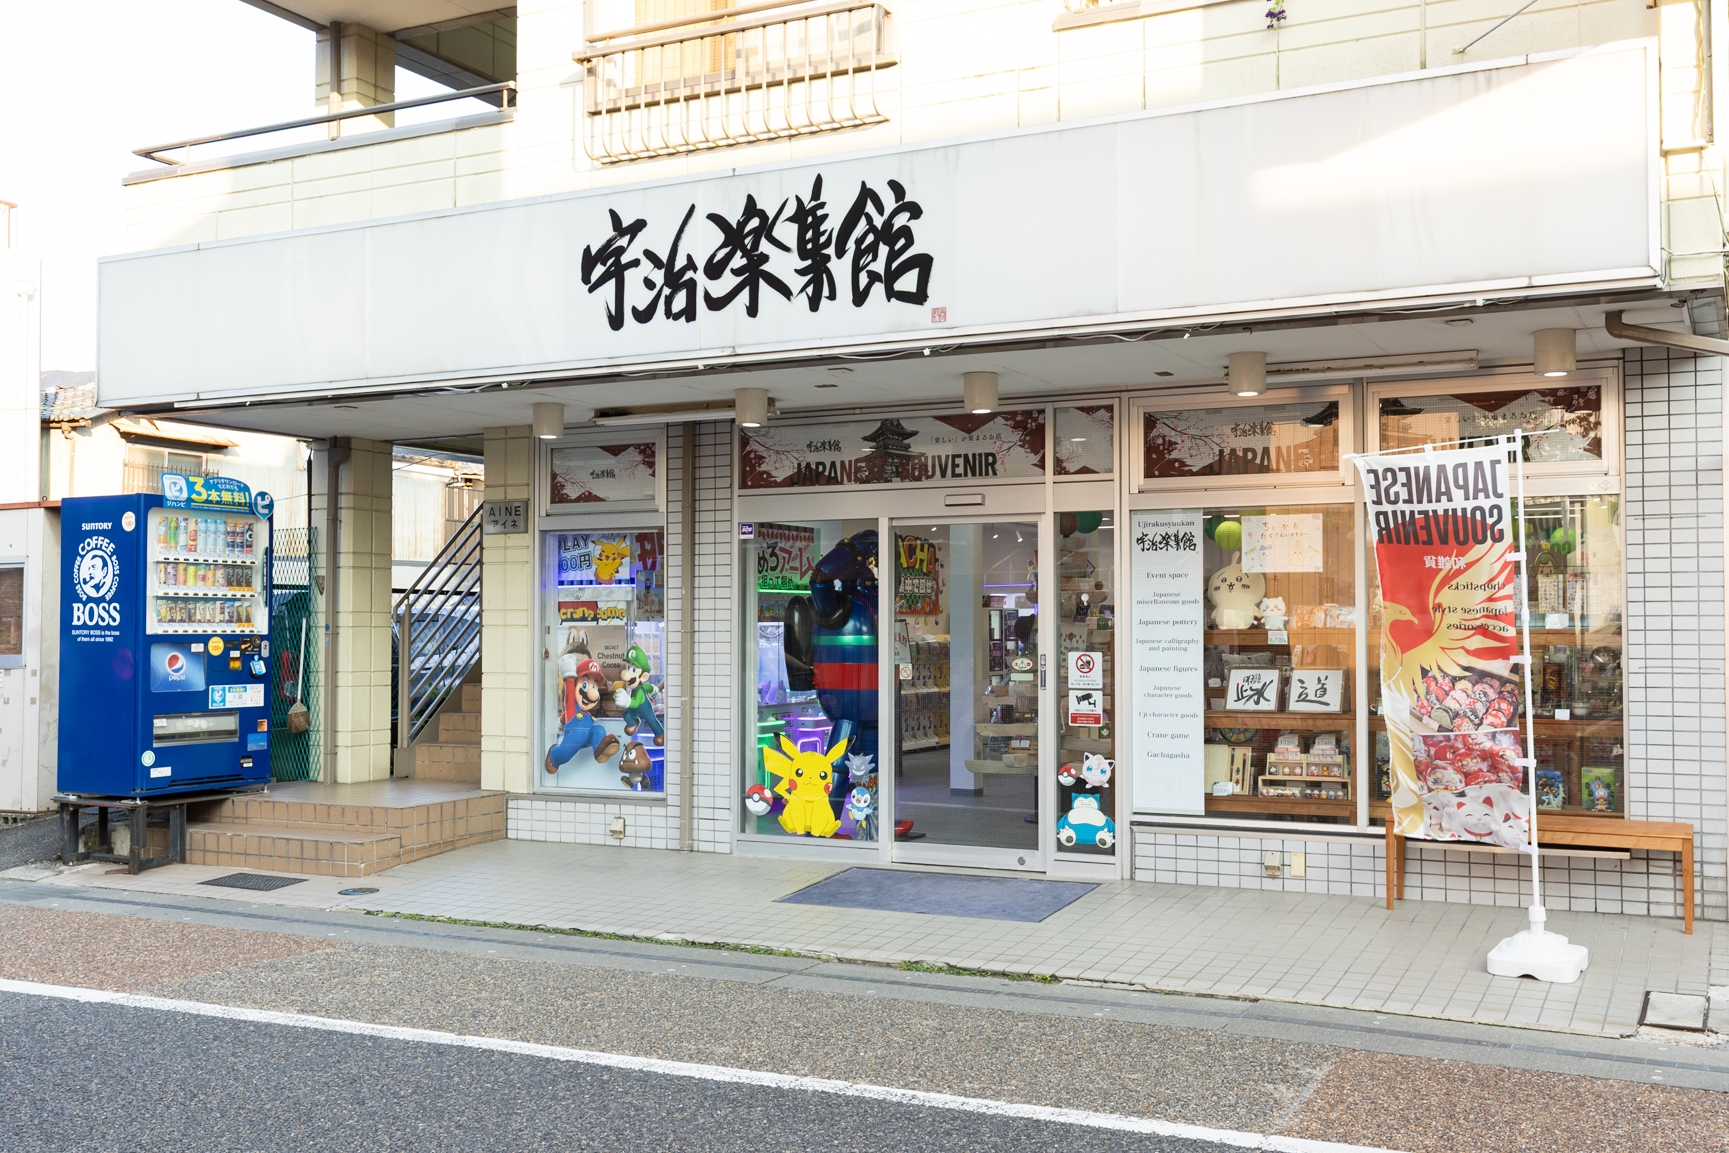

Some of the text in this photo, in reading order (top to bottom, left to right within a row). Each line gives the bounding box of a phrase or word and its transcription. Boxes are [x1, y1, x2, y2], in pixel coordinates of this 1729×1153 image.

[581, 173, 934, 331] 宇治楽集館
[899, 452, 998, 482] SOUVENIR
[257, 495, 270, 514] ピ
[488, 506, 522, 517] AINE
[82, 522, 112, 530] SUNTORY
[491, 519, 518, 530] アイネ
[1138, 520, 1194, 528] Ujirakusyuukan
[78, 536, 116, 556] COFFEE
[1136, 530, 1196, 552] 宇治楽集館
[559, 553, 591, 572] 00円
[72, 602, 120, 626] BOSS
[1294, 675, 1331, 706] 道
